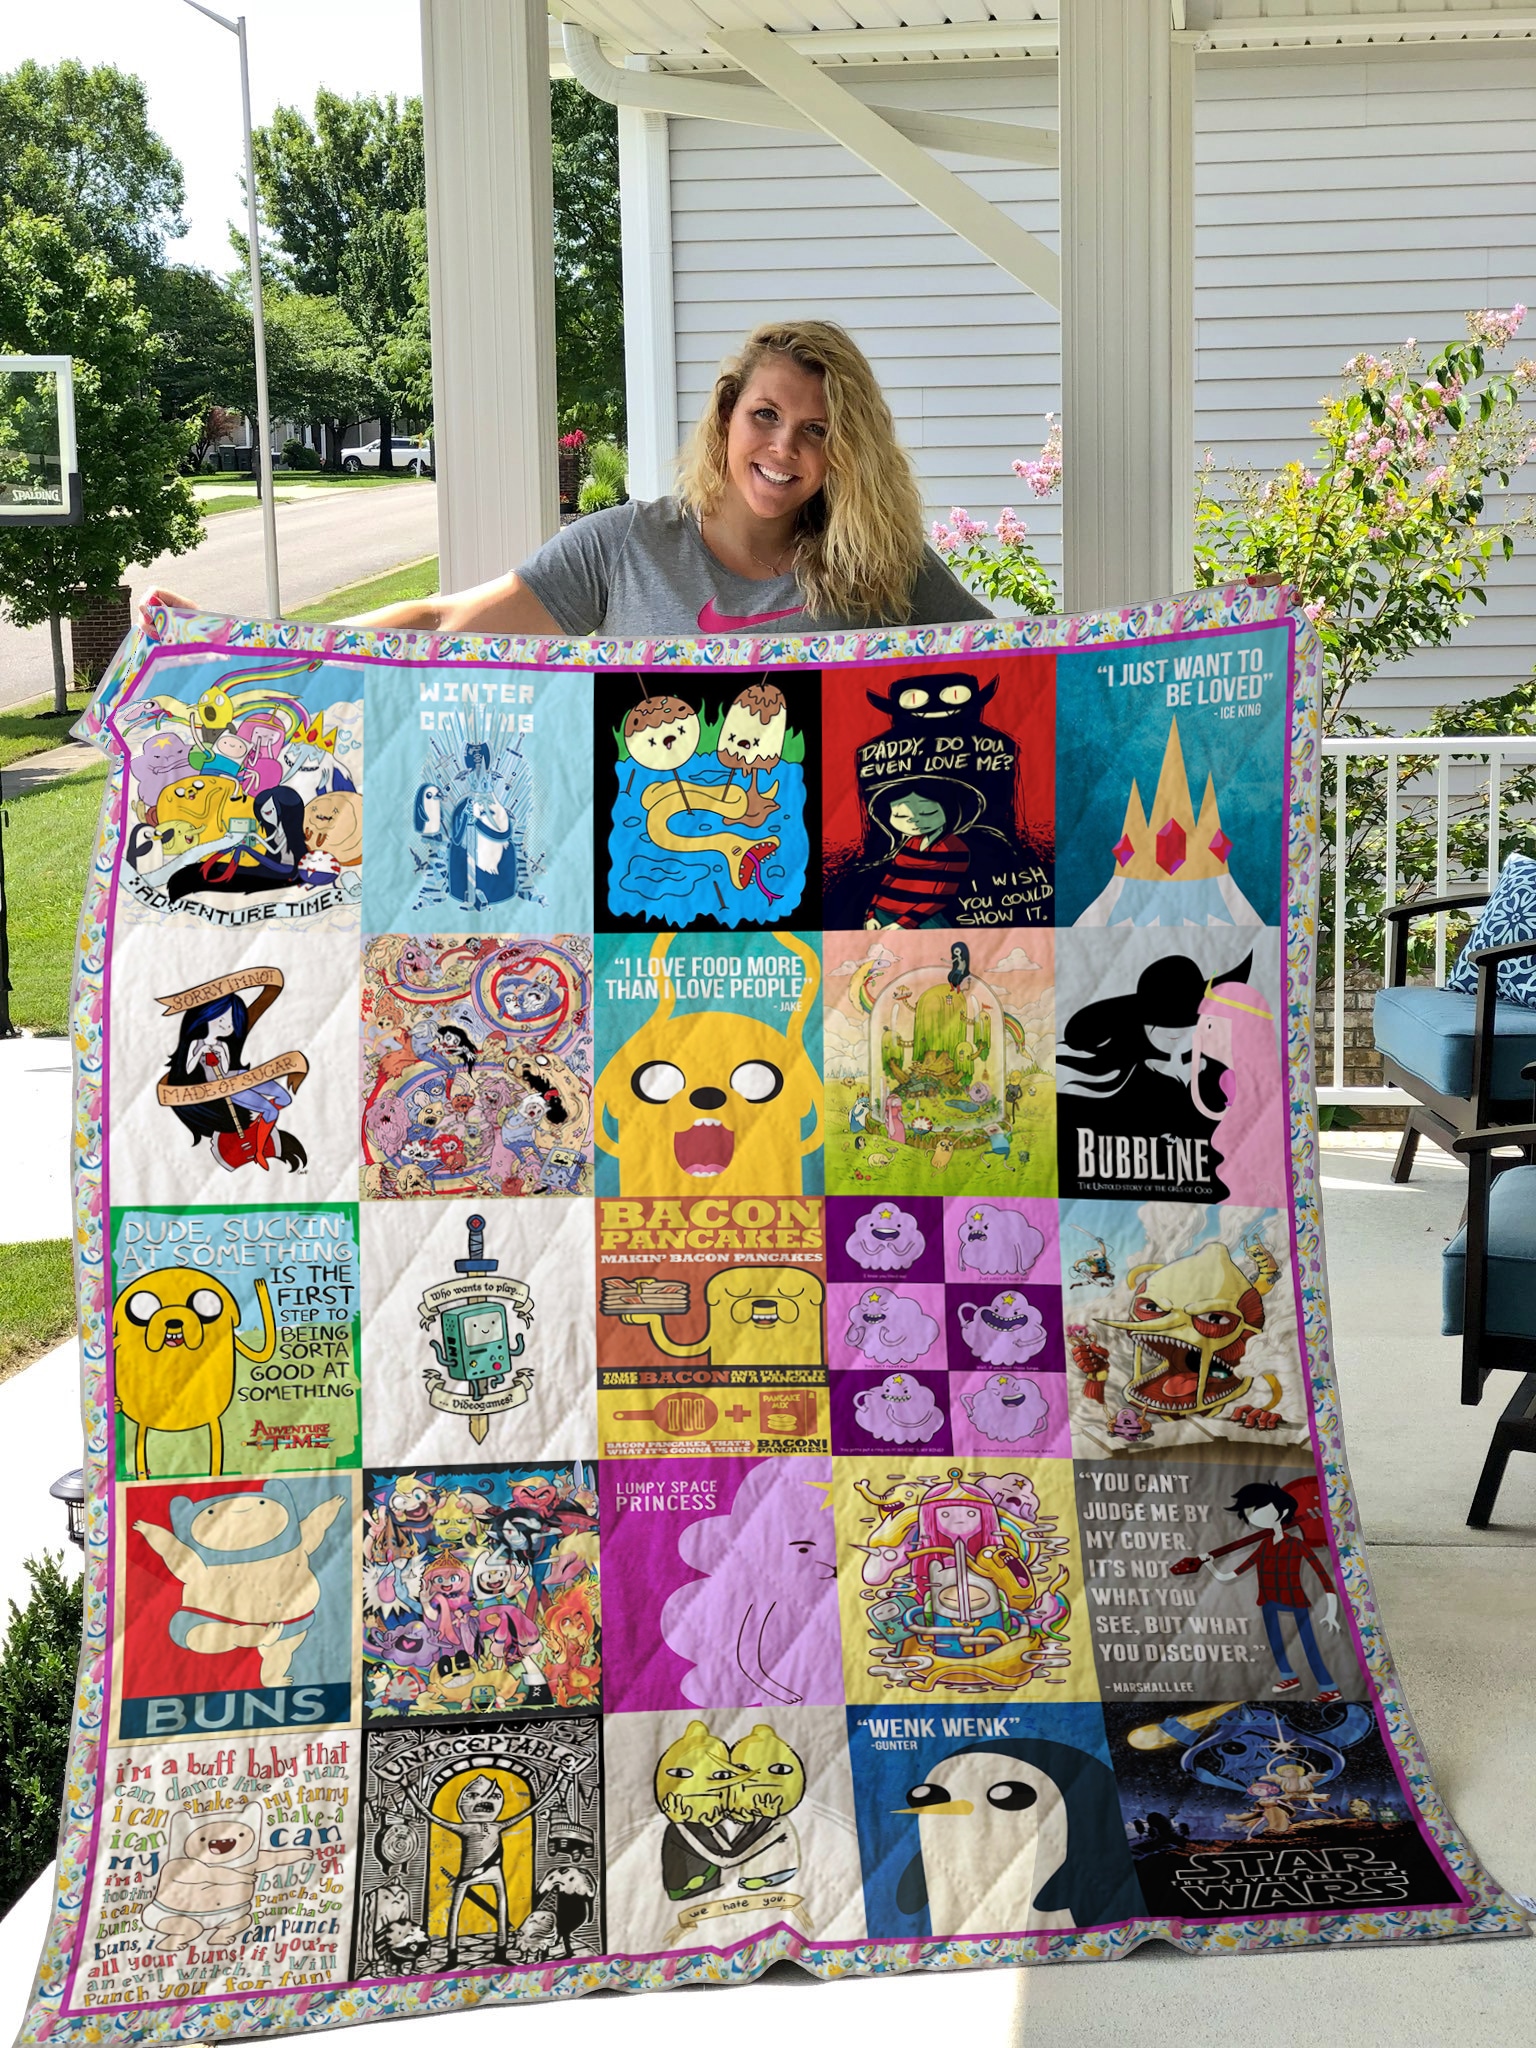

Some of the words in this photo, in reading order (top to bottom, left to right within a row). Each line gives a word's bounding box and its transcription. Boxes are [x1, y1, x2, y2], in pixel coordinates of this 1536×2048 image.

[12, 489, 61, 501] SPALDING
[1119, 659, 1169, 686] JUST
[1173, 651, 1233, 681] WANT
[1237, 647, 1263, 673] TO
[419, 682, 534, 704] WINTER
[1166, 682, 1192, 707] BE
[1220, 706, 1235, 719] ICE
[1237, 703, 1261, 718] KING
[859, 736, 926, 762] DADDY,
[934, 737, 964, 752] DO
[971, 735, 1005, 752] YOU
[860, 757, 912, 777] EVEN
[924, 753, 971, 772] LOVE
[976, 753, 1014, 771] ME?
[971, 880, 977, 892] I
[992, 866, 1048, 886] WISH
[286, 892, 333, 918] TIME
[958, 896, 992, 911] YOU
[1001, 884, 1054, 906] COULD
[956, 908, 1014, 925] SHOW
[1026, 906, 1048, 921] IT.
[637, 957, 686, 978] LOVE
[691, 956, 741, 977] FOOD
[747, 956, 803, 977] MORE
[172, 982, 224, 1011] SORRY
[227, 976, 247, 991] I'M
[248, 970, 276, 986] NOT
[605, 979, 658, 999] THAN
[664, 979, 670, 999] I
[675, 978, 724, 999] LOVE
[779, 1001, 803, 1012] JAKE
[162, 1083, 217, 1104] MADE
[218, 1079, 239, 1093] OF
[241, 1057, 298, 1087] SUGAR
[1076, 1127, 1211, 1186] BUBBLINE
[600, 1199, 823, 1229] BACON
[124, 1220, 212, 1245] DUDE,
[600, 1229, 824, 1250] PANCAKES
[121, 1245, 162, 1269] AT
[173, 1241, 353, 1267] SOMETHING
[670, 1253, 729, 1263] BACON
[734, 1253, 824, 1262] PANCAKES
[270, 1267, 296, 1284] IS
[307, 1264, 352, 1283] THE
[278, 1286, 355, 1307] FIRST
[430, 1288, 452, 1301] Who
[453, 1283, 482, 1295] wants
[484, 1282, 495, 1291] to
[281, 1308, 319, 1323] STEP
[326, 1308, 348, 1321] TO
[281, 1325, 349, 1342] BEING
[280, 1342, 350, 1360] SORTA
[250, 1364, 315, 1381] GOOD
[323, 1361, 350, 1379] AT
[639, 1371, 730, 1385] BACON
[237, 1383, 354, 1402] SOMETHING
[763, 1393, 801, 1402] PANCAKE
[250, 1419, 331, 1437] ADVENTURE
[266, 1433, 330, 1452] TIME
[757, 1439, 821, 1447] BACON
[616, 1481, 666, 1495] LUMPY
[671, 1480, 718, 1494] SPACE
[616, 1494, 717, 1512] PRINCESS
[1083, 1502, 1146, 1521] JUDGE
[1151, 1503, 1180, 1522] ME
[1185, 1504, 1210, 1523] BY
[1086, 1530, 1115, 1549] MY
[1121, 1531, 1192, 1550] COVER.
[1089, 1559, 1126, 1578] IT'S
[1131, 1560, 1169, 1578] NOT
[1091, 1587, 1154, 1606] WHAT
[1155, 1588, 1197, 1607] YOU
[1095, 1615, 1140, 1636] SEE,
[1144, 1616, 1182, 1634] BUT
[1188, 1616, 1249, 1635] WHAT
[1099, 1643, 1140, 1662] YOU
[1113, 1682, 1172, 1693] MARSHALL
[1174, 1682, 1194, 1693] LEE
[146, 1688, 326, 1735] BUNS
[161, 1759, 178, 1775] a
[187, 1749, 237, 1776] buff
[247, 1746, 298, 1779] baby
[304, 1741, 350, 1766] that
[114, 1784, 156, 1805] can
[165, 1776, 229, 1802] dance
[232, 1775, 272, 1793] like
[283, 1777, 295, 1788] a
[127, 1807, 170, 1828] can
[182, 1790, 249, 1814] shake-a
[296, 1785, 349, 1806] fanny
[123, 1830, 167, 1852] can
[266, 1804, 344, 1827] shake-a
[269, 1825, 342, 1847] can
[1175, 1848, 1398, 1880] STAR
[257, 1862, 316, 1892] baby
[1221, 1872, 1343, 1885] ADVENTURE
[1359, 1869, 1409, 1878] TIME
[110, 1902, 144, 1919] can
[254, 1886, 318, 1908] puncha
[319, 1877, 344, 1894] yo
[1180, 1876, 1410, 1910] WARS
[689, 1907, 709, 1918] we
[723, 1899, 750, 1911] hate
[763, 1895, 786, 1906] you.
[96, 1919, 143, 1939] buns,
[252, 1903, 316, 1925] puncha
[318, 1899, 343, 1914] yo
[94, 1939, 142, 1961] buns,
[241, 1925, 277, 1944] can
[281, 1917, 340, 1936] punch
[87, 1957, 120, 1978] all
[128, 1953, 178, 1971] your
[186, 1944, 245, 1966] buns!
[250, 1945, 268, 1961] if
[274, 1937, 338, 1963] you're
[87, 1979, 115, 1992] an
[122, 1968, 165, 1987] evil
[158, 1981, 208, 1999] you
[222, 1976, 272, 1992] for
[278, 1970, 332, 1987] fun!
